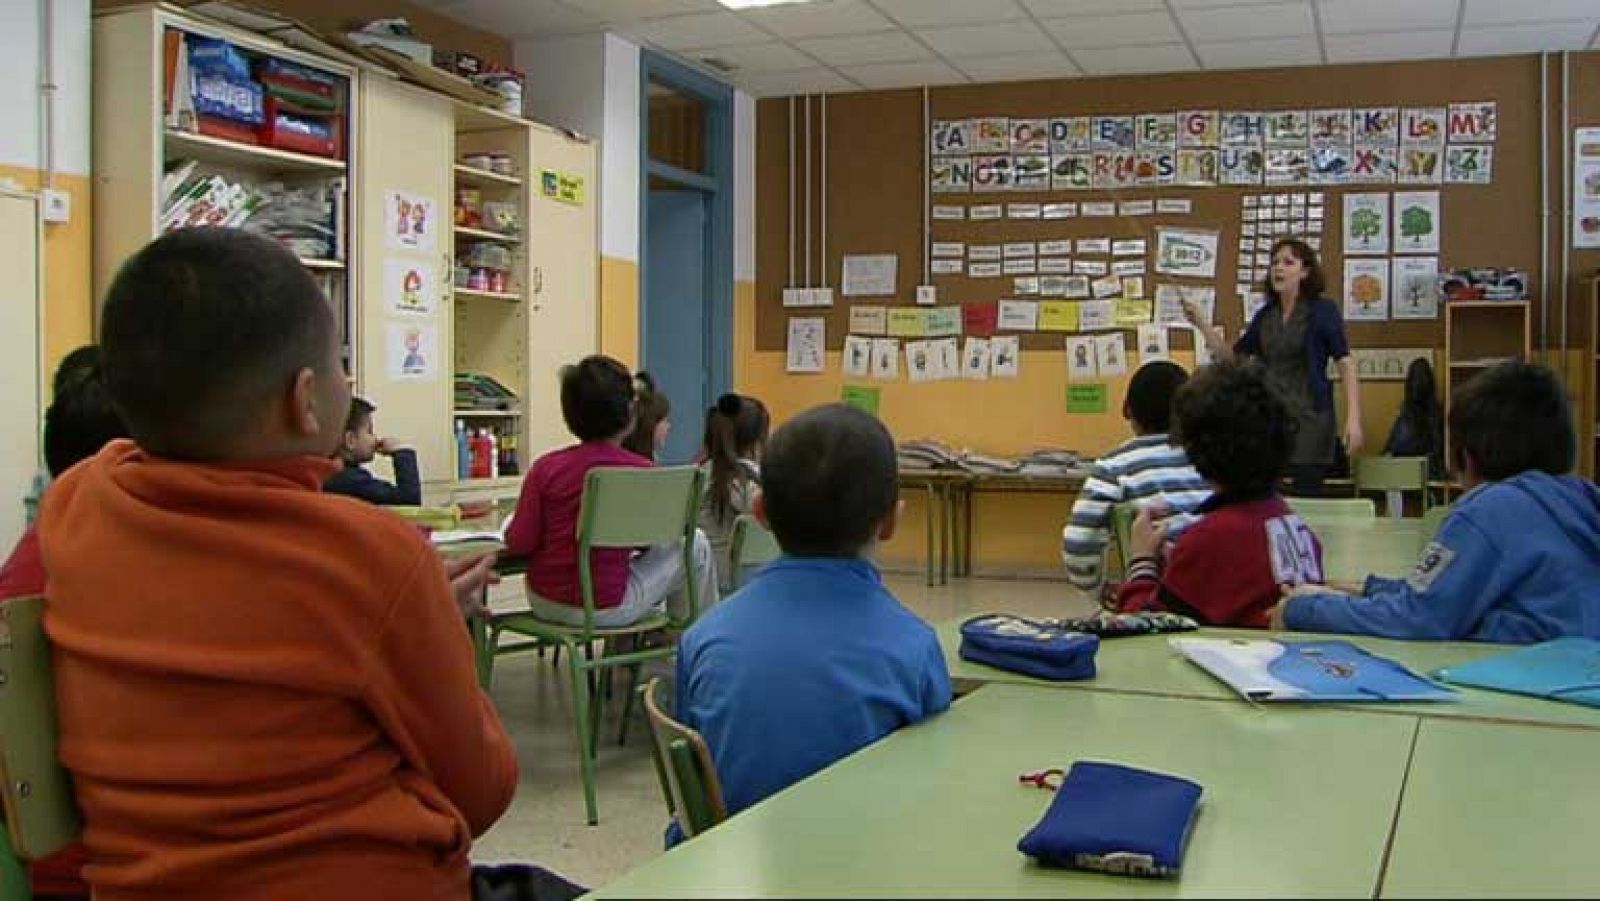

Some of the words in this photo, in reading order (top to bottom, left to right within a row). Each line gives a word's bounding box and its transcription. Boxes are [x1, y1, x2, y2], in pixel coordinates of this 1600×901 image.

[1051, 122, 1068, 141] D
[1101, 119, 1114, 139] E
[1144, 118, 1158, 139] F
[1187, 114, 1204, 135] G
[1245, 116, 1263, 137] H
[1365, 112, 1381, 132] K
[1409, 116, 1422, 137] L
[1451, 114, 1476, 135] M
[947, 127, 964, 148] A
[1159, 156, 1173, 176] S
[1222, 150, 1239, 170] U
[1354, 150, 1374, 173] X
[951, 163, 970, 185] N
